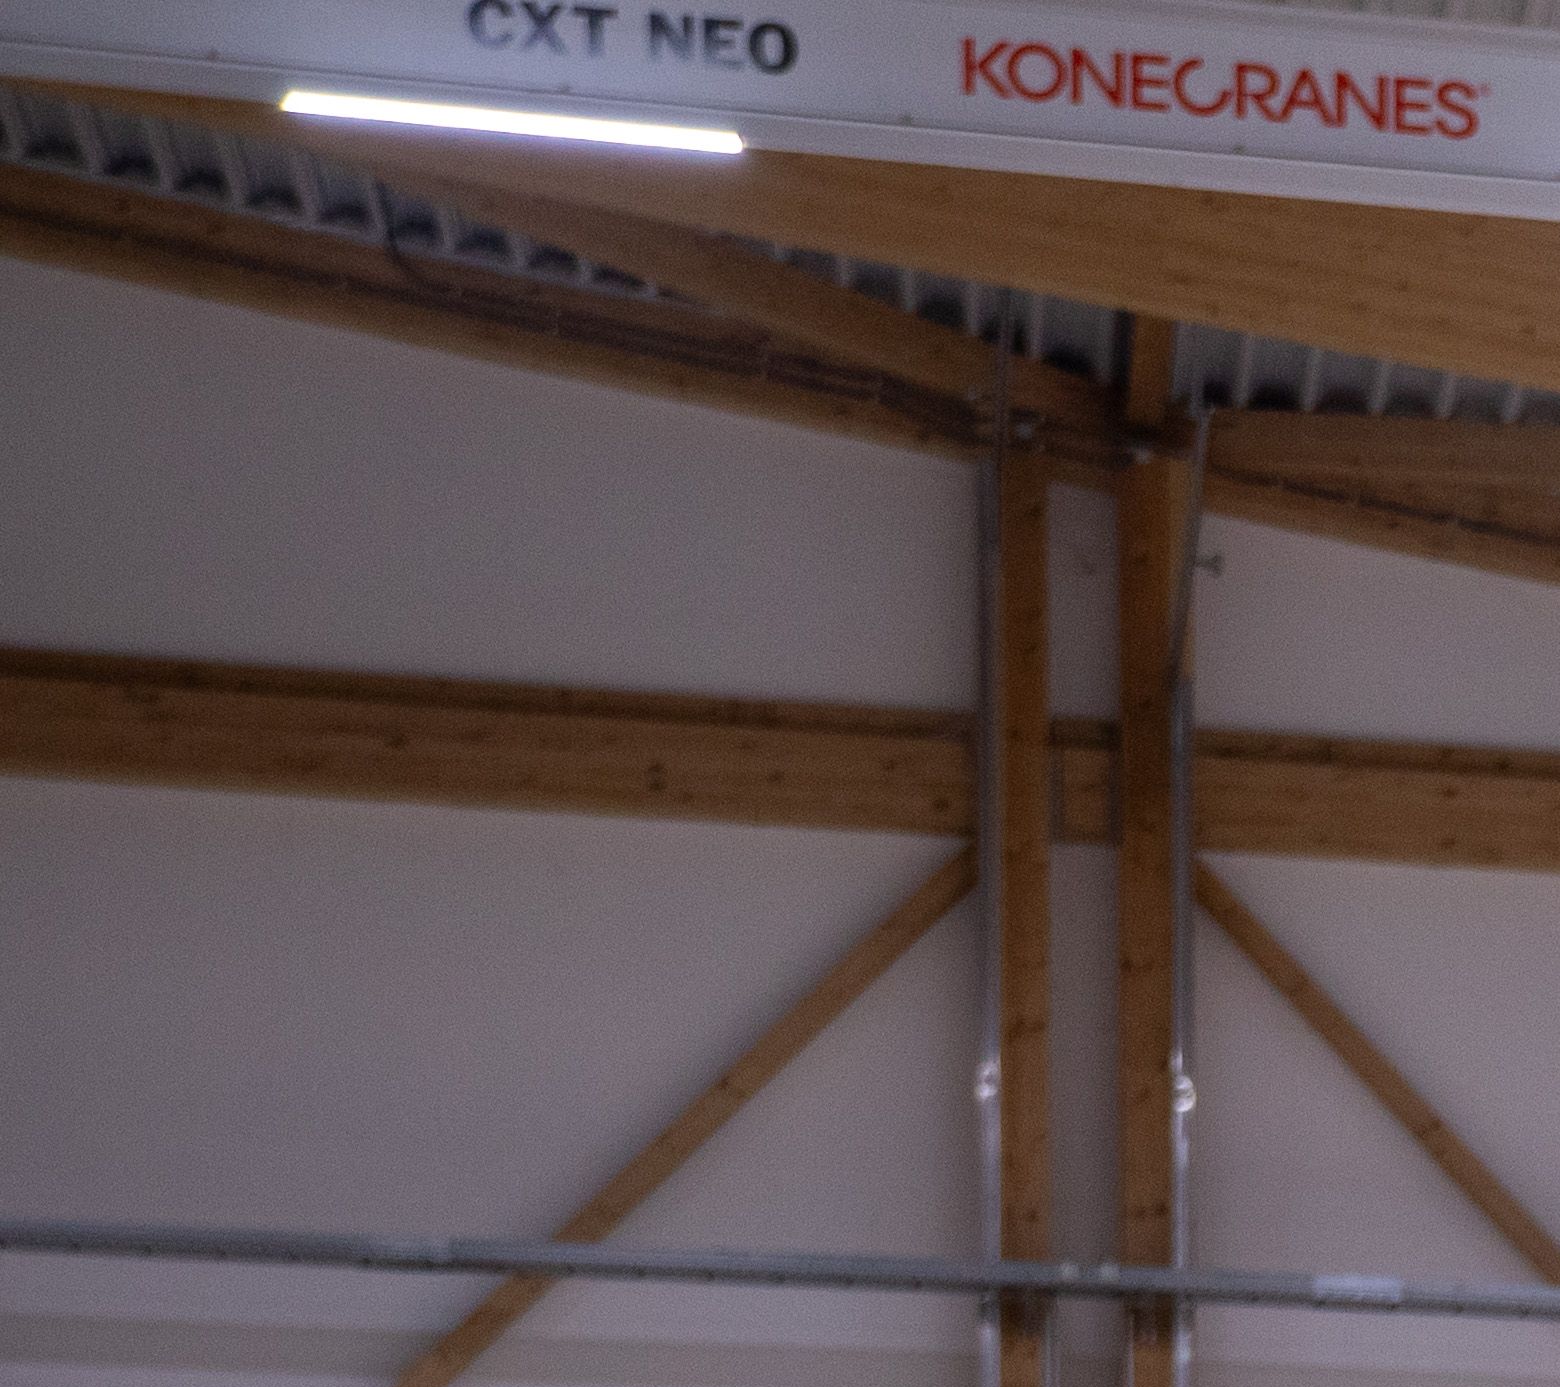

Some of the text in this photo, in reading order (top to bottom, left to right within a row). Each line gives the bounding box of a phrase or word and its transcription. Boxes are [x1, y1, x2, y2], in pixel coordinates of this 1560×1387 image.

[466, 0, 799, 75] CXT NEO
[960, 37, 1480, 140] KONECRANES
